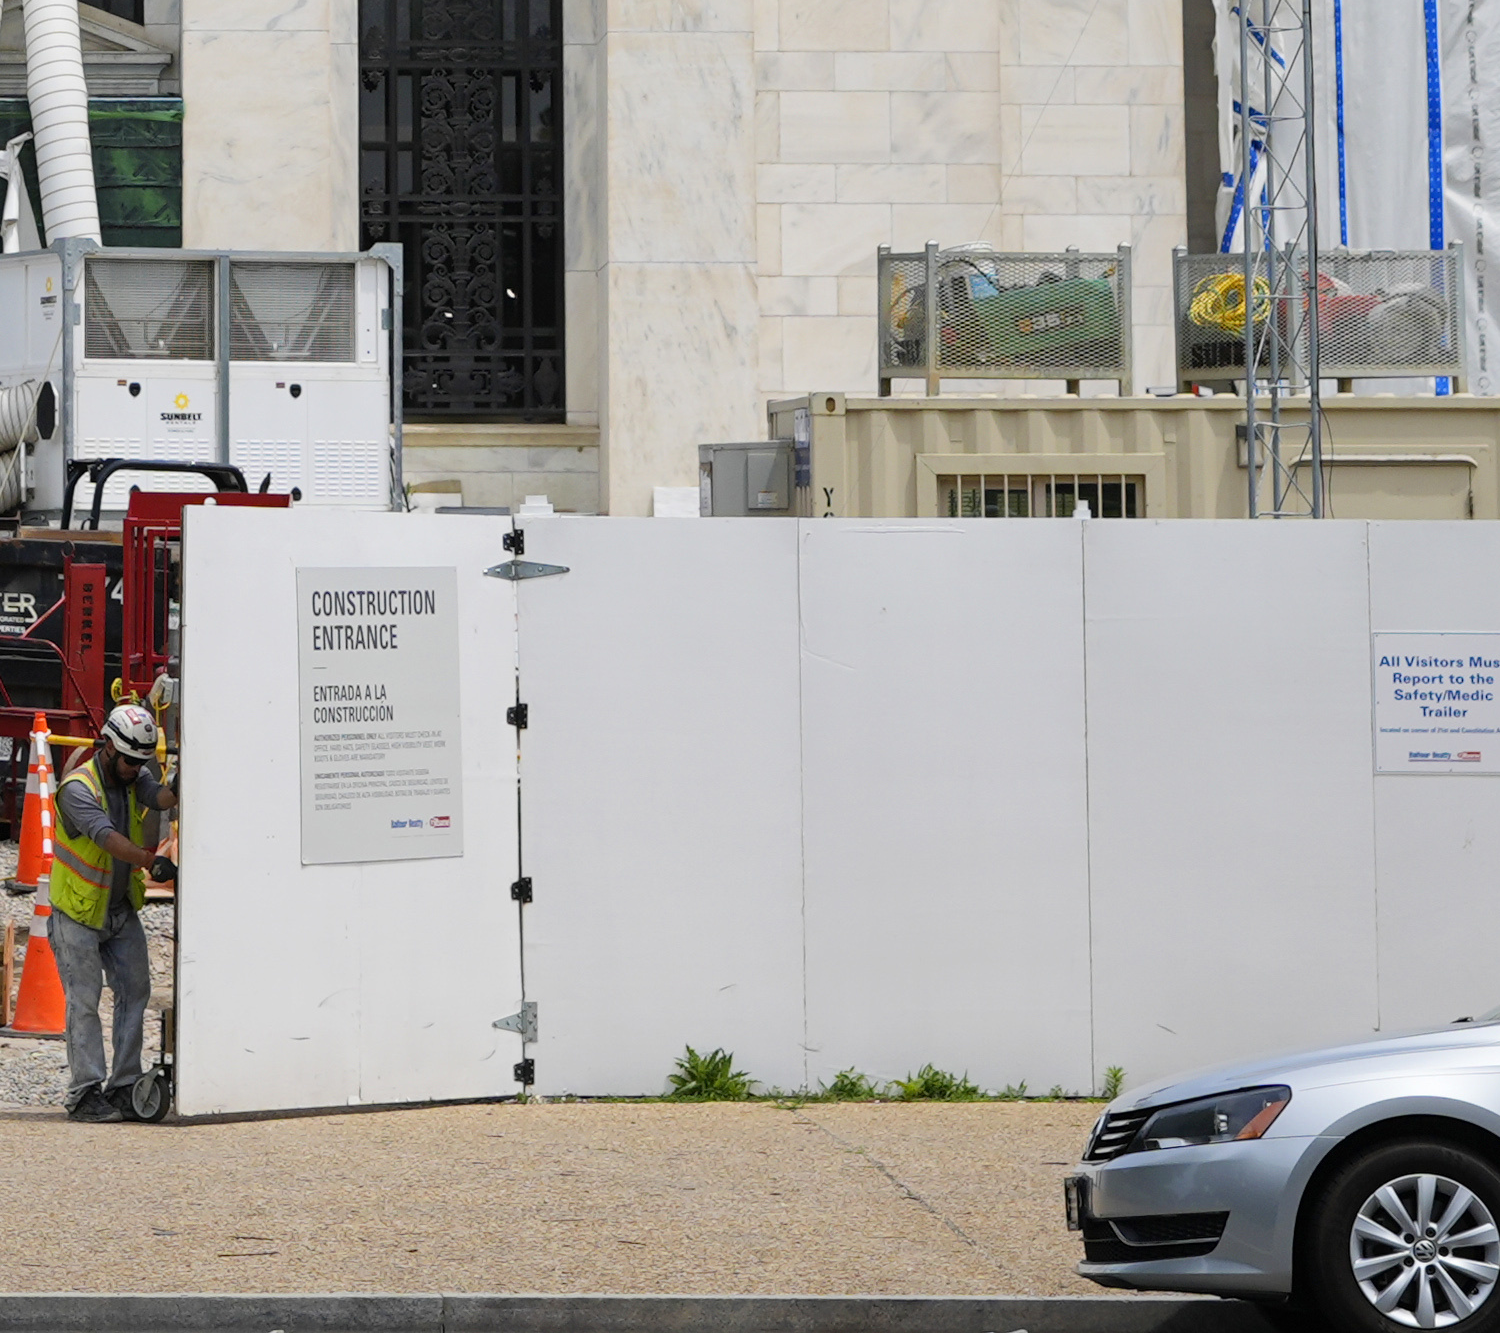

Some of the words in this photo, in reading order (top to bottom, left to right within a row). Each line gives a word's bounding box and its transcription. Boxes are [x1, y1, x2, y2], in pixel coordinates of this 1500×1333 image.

[159, 412, 203, 421] SUNBELT
[311, 589, 436, 617] CONSTRUCTION
[312, 624, 398, 651] ENTRANCE
[1379, 655, 1400, 668] All
[1404, 655, 1464, 668] Visitors
[1392, 673, 1444, 687] Report
[1449, 674, 1465, 685] to
[1469, 673, 1495, 685] the
[313, 684, 362, 702] ENTRADA
[364, 684, 372, 701] A
[375, 684, 387, 701] LA
[1394, 689, 1495, 703] Safety/Medic
[313, 701, 394, 724] CONSTRUCCIÓN
[1420, 706, 1469, 718] Trailer
